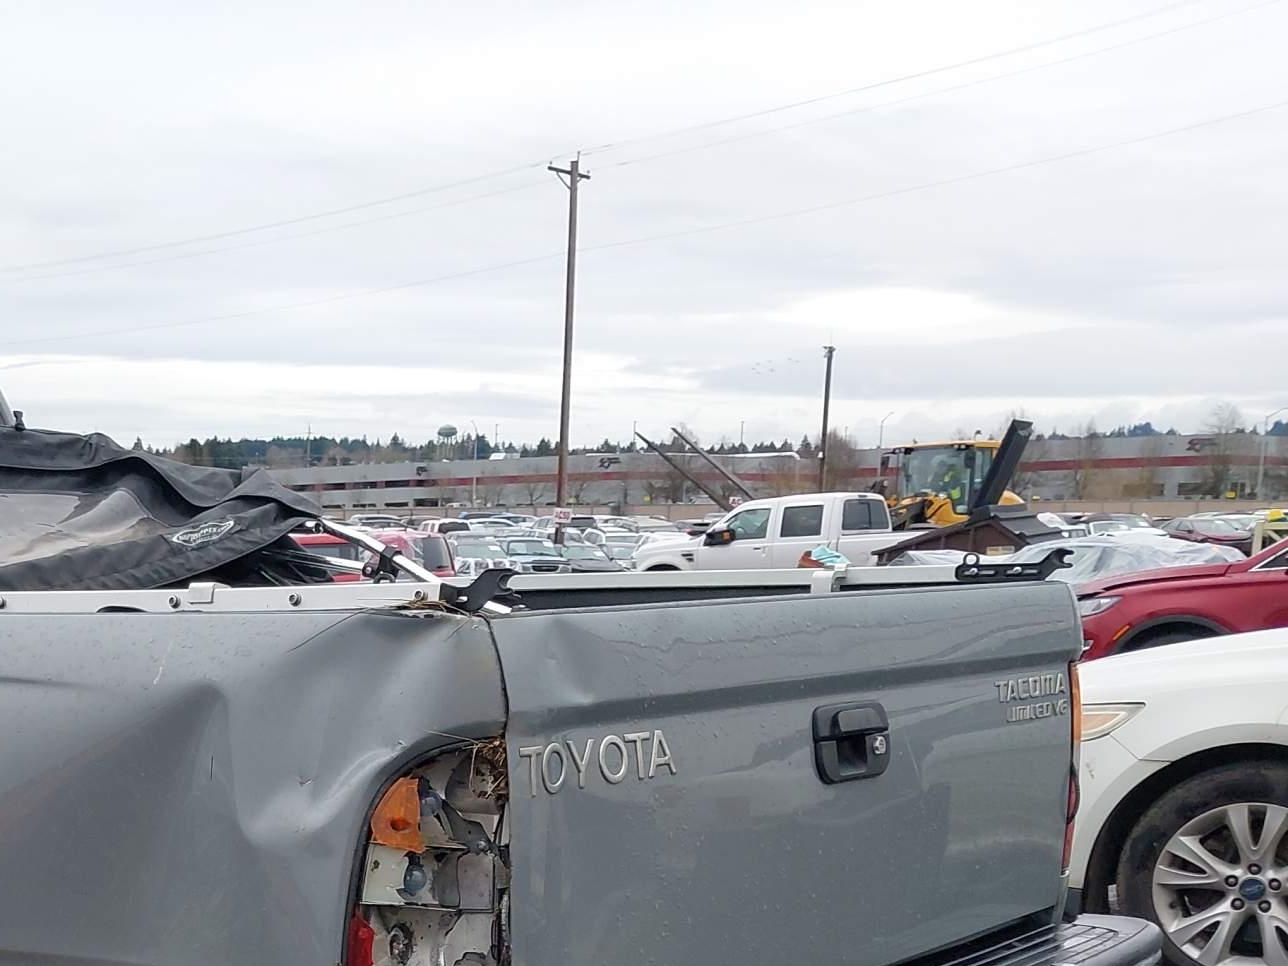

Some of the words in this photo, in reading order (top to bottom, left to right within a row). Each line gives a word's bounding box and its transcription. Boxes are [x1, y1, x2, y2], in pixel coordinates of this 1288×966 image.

[994, 673, 1066, 703] TACOMA
[1007, 702, 1051, 723] LIMITED
[1051, 698, 1068, 716] V6
[519, 729, 677, 798] TOYOTA
